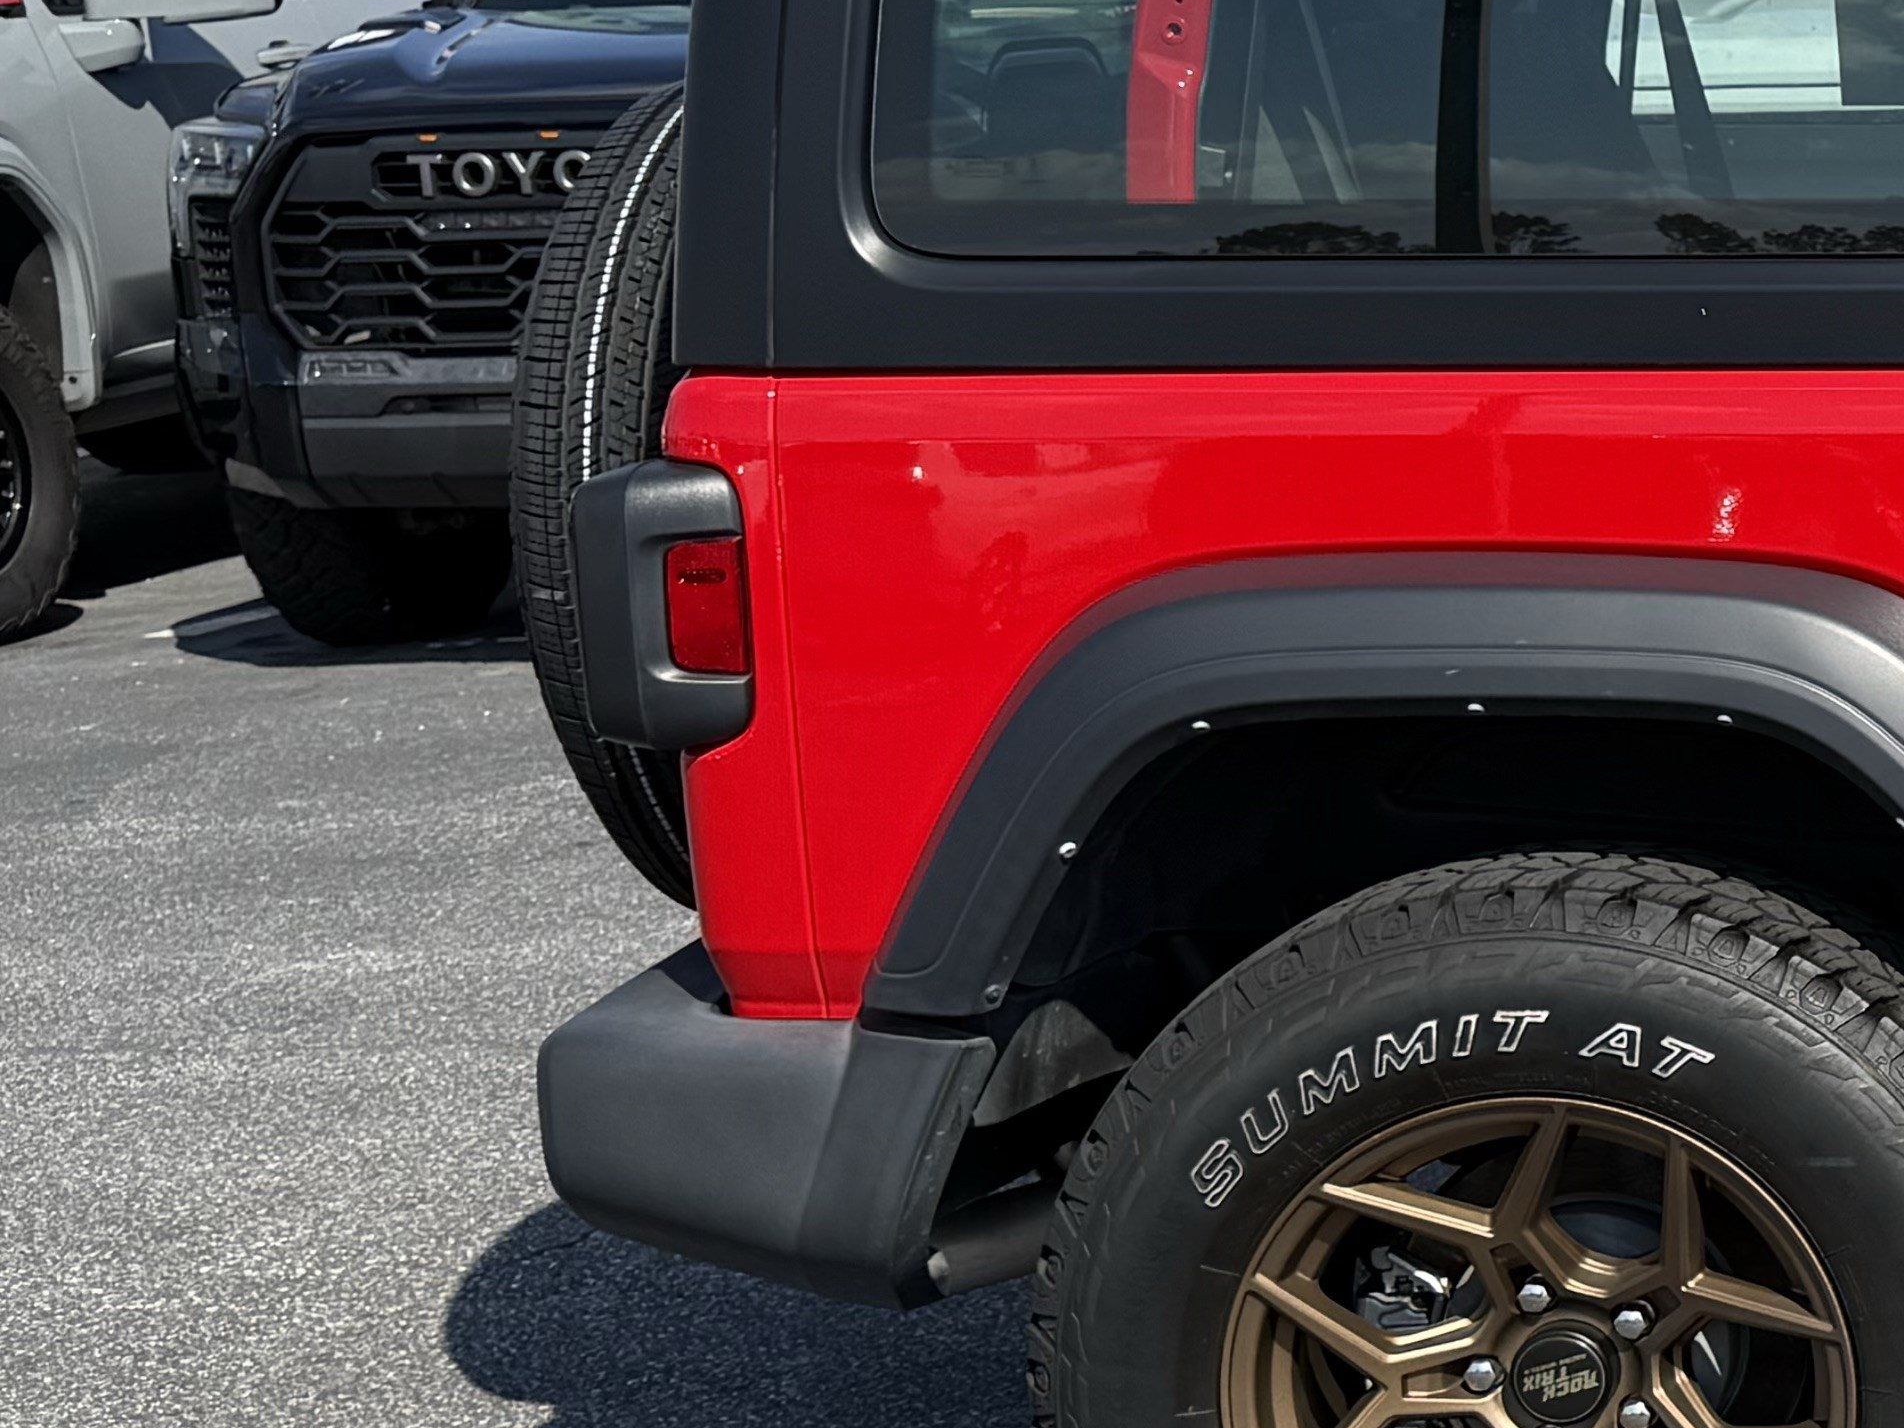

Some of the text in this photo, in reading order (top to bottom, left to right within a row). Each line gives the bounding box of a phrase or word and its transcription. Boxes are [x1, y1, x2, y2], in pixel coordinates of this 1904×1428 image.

[1189, 1009, 1549, 1209] SUMMIT
[1578, 1023, 1716, 1080] AT
[1542, 1369, 1600, 1403] ROCK
